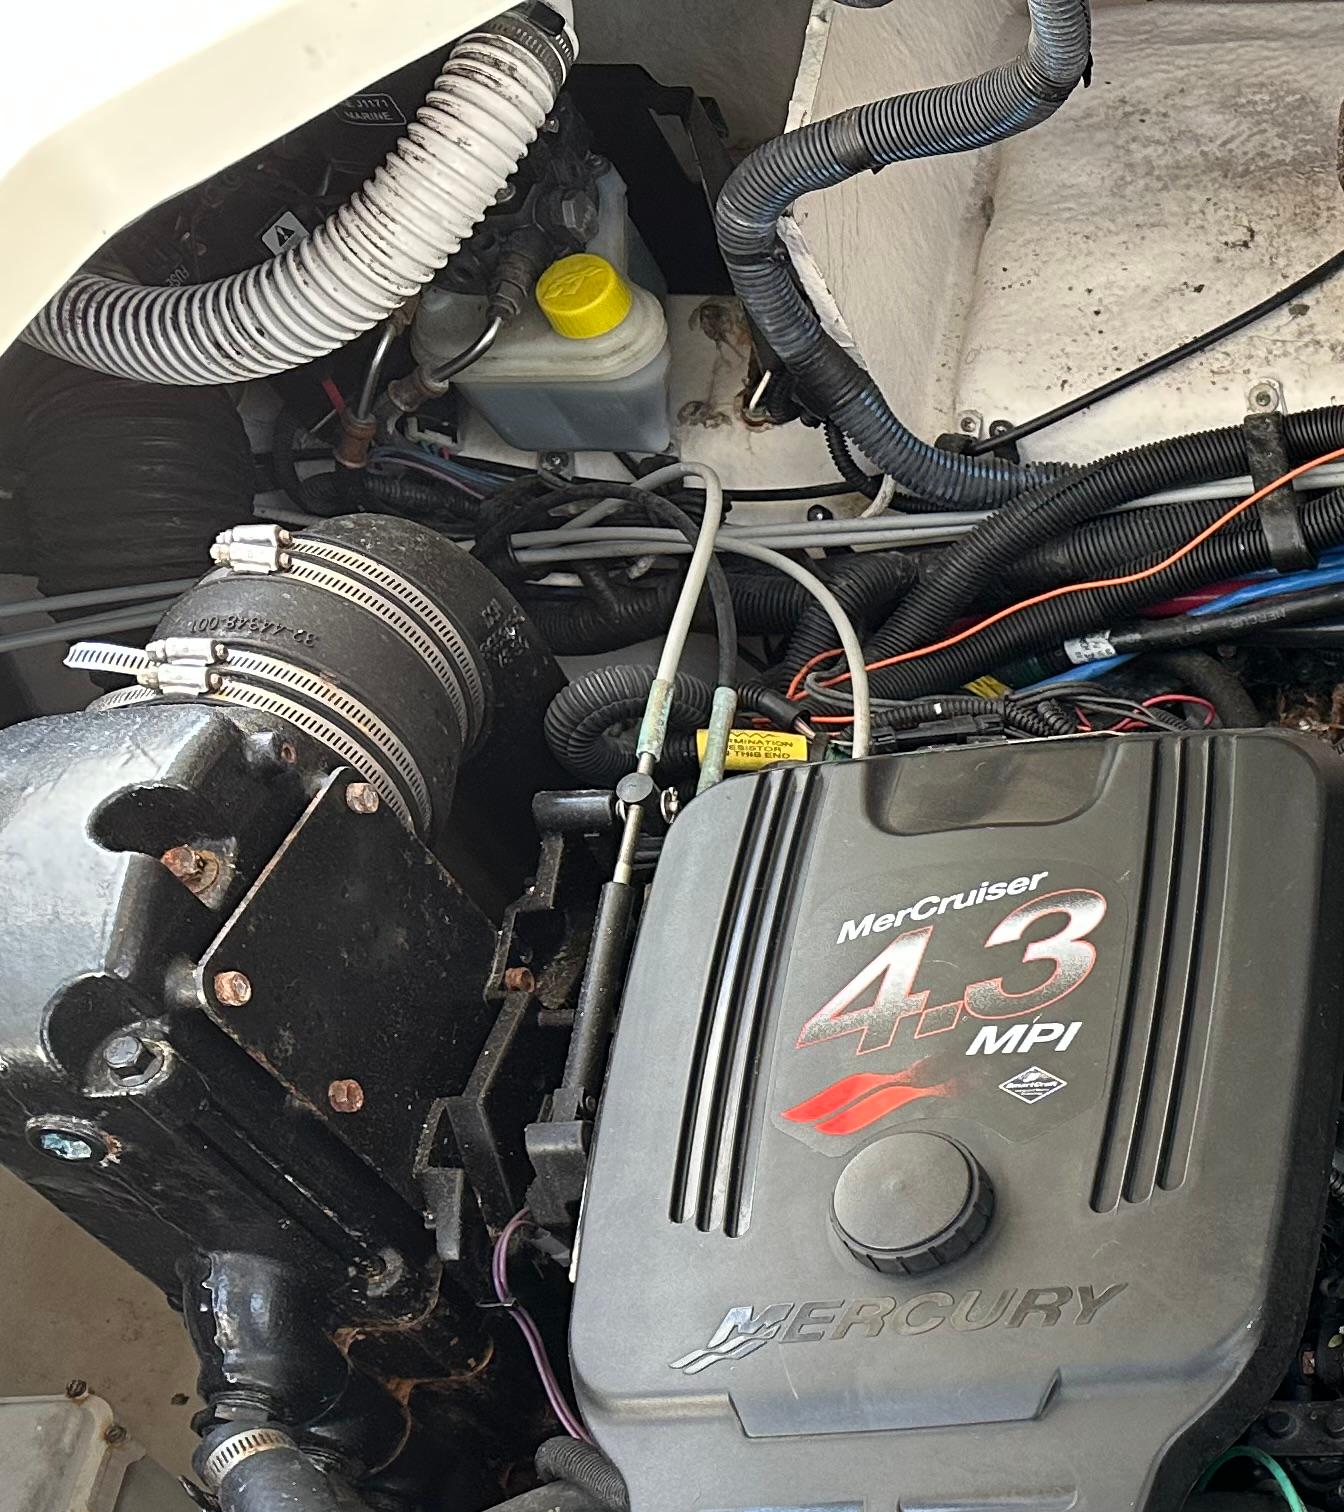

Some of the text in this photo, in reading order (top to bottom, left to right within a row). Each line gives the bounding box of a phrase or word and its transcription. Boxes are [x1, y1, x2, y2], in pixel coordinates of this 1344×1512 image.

[728, 738, 793, 747] MINATION
[728, 744, 781, 753] ESISTOR
[836, 872, 1049, 945] MerCruiser
[796, 888, 1108, 1056] 4.3
[965, 1020, 1083, 1055] MPI
[705, 1283, 1129, 1350] MERCURY
